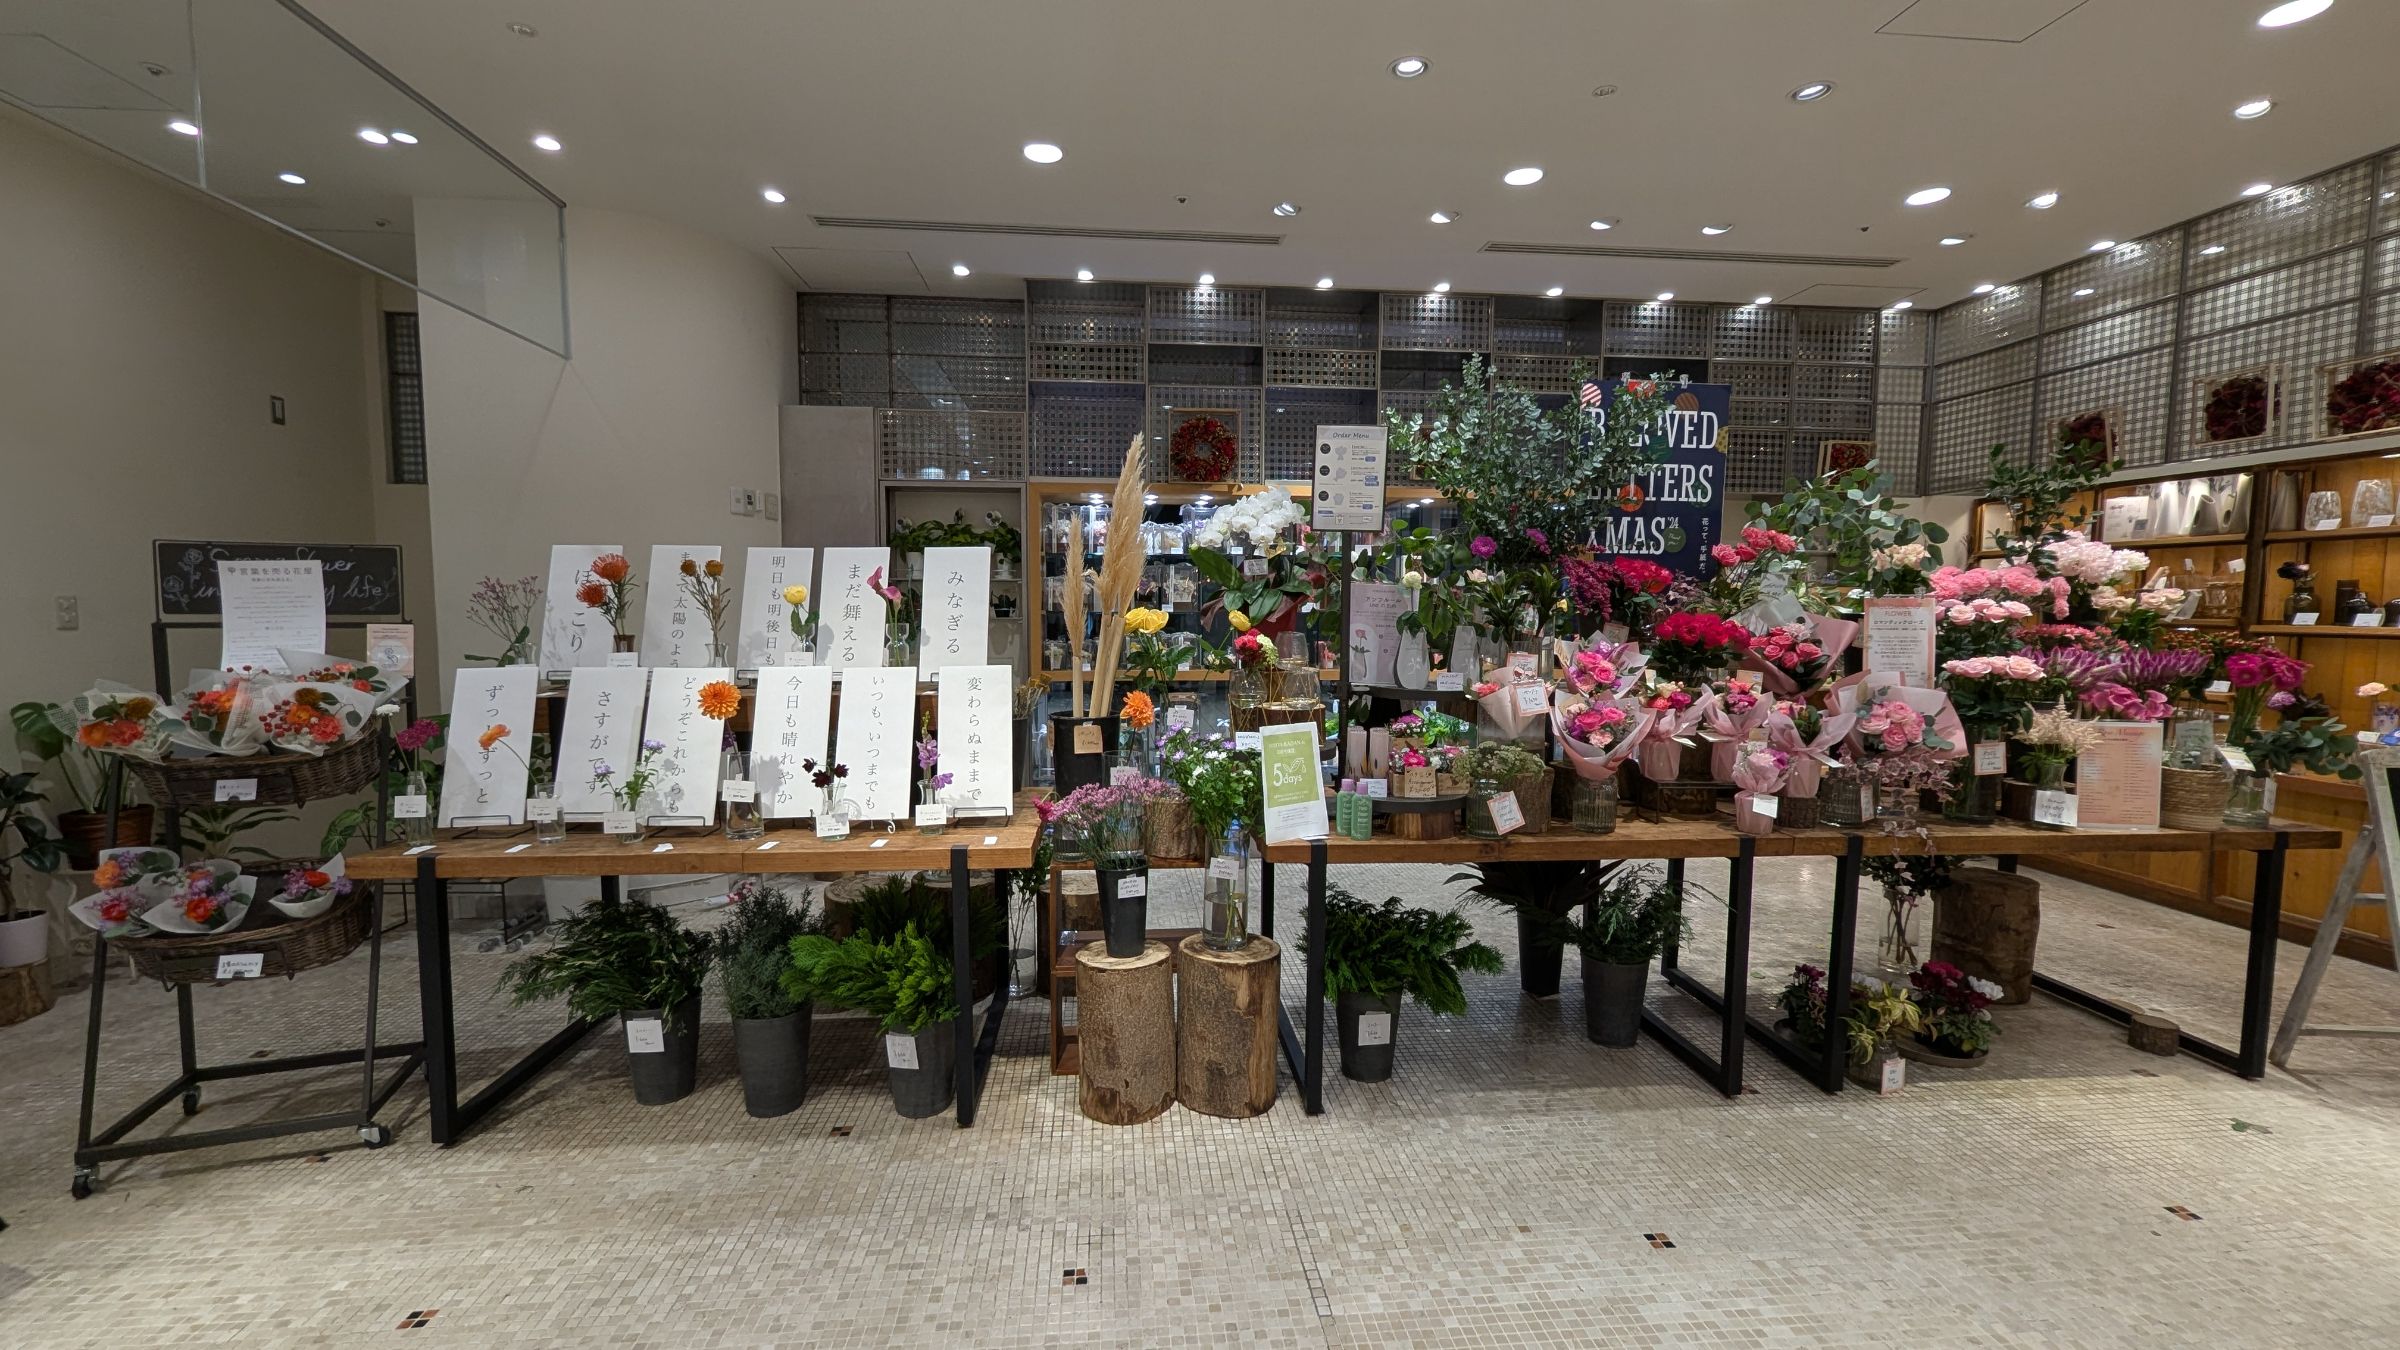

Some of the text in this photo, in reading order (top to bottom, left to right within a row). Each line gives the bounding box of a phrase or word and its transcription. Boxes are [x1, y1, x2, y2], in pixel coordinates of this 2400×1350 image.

[571, 569, 593, 653] ほこり
[670, 552, 691, 668] まで太陽のよう
[765, 555, 786, 666] 明日も明後日も
[842, 563, 862, 662] まだ舞える
[946, 570, 965, 655] みなぎる
[476, 684, 504, 804] ずっずっと
[668, 676, 697, 813] どうぞこれからも
[776, 675, 803, 805] 今日も晴れやか
[864, 676, 887, 809] いつも、いつまでも
[966, 676, 983, 801] 変わらぬままで
[1273, 762, 1303, 787] 5 days
